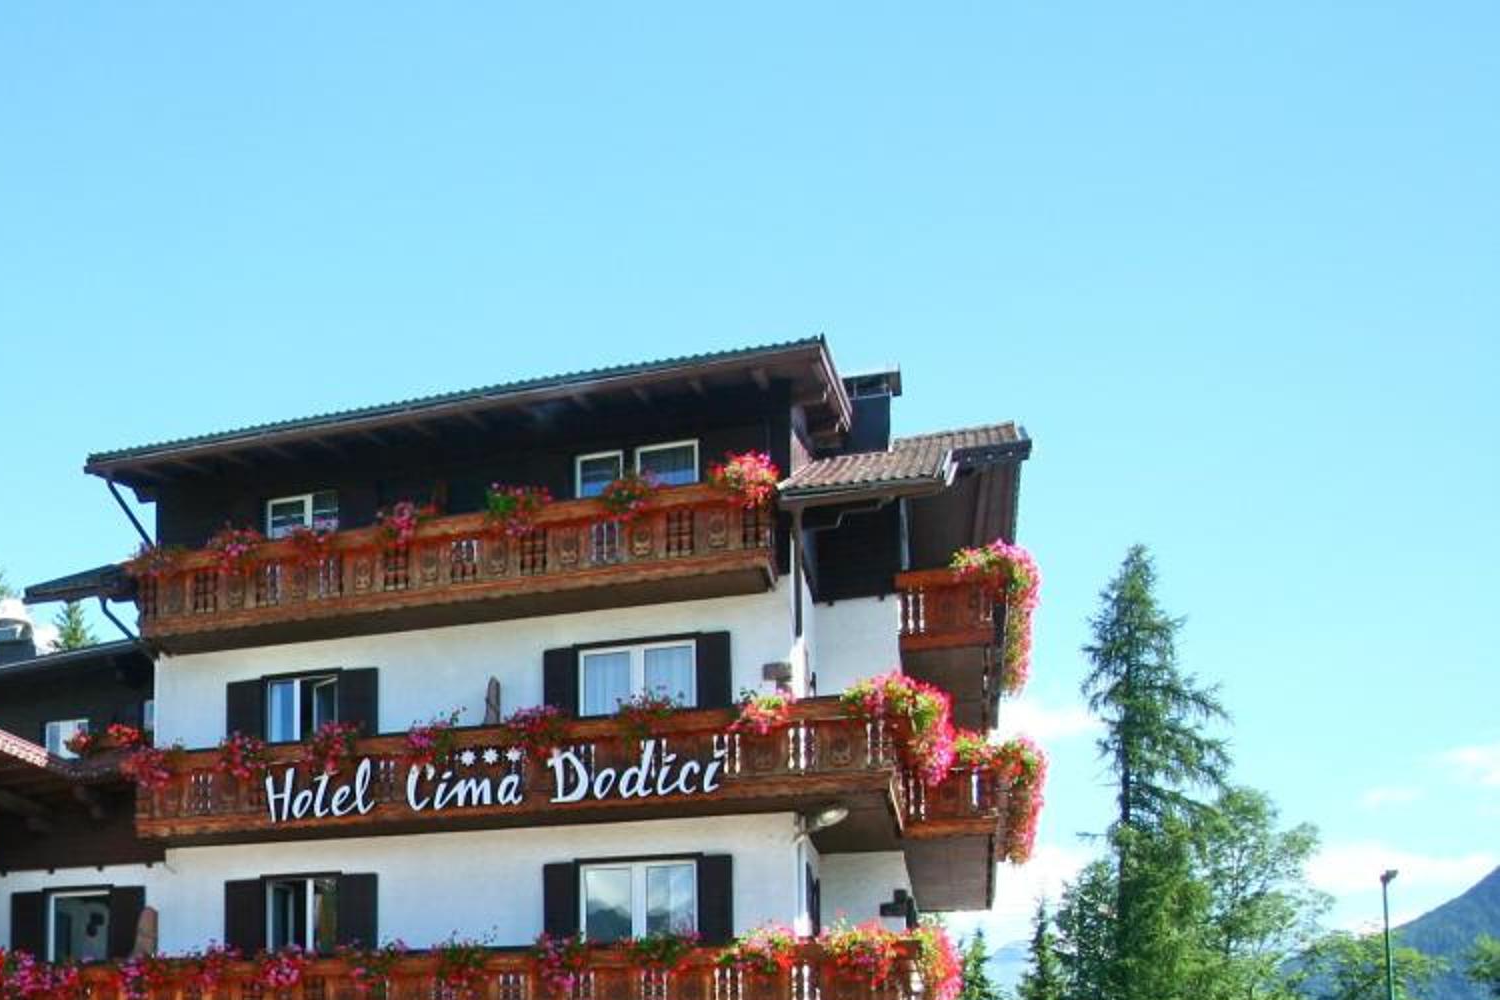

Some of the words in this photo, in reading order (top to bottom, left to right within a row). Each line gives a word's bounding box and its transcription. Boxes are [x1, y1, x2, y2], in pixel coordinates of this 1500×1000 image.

[265, 757, 375, 823] Hotel
[406, 763, 523, 812] Cima
[547, 739, 729, 803] Dodici
